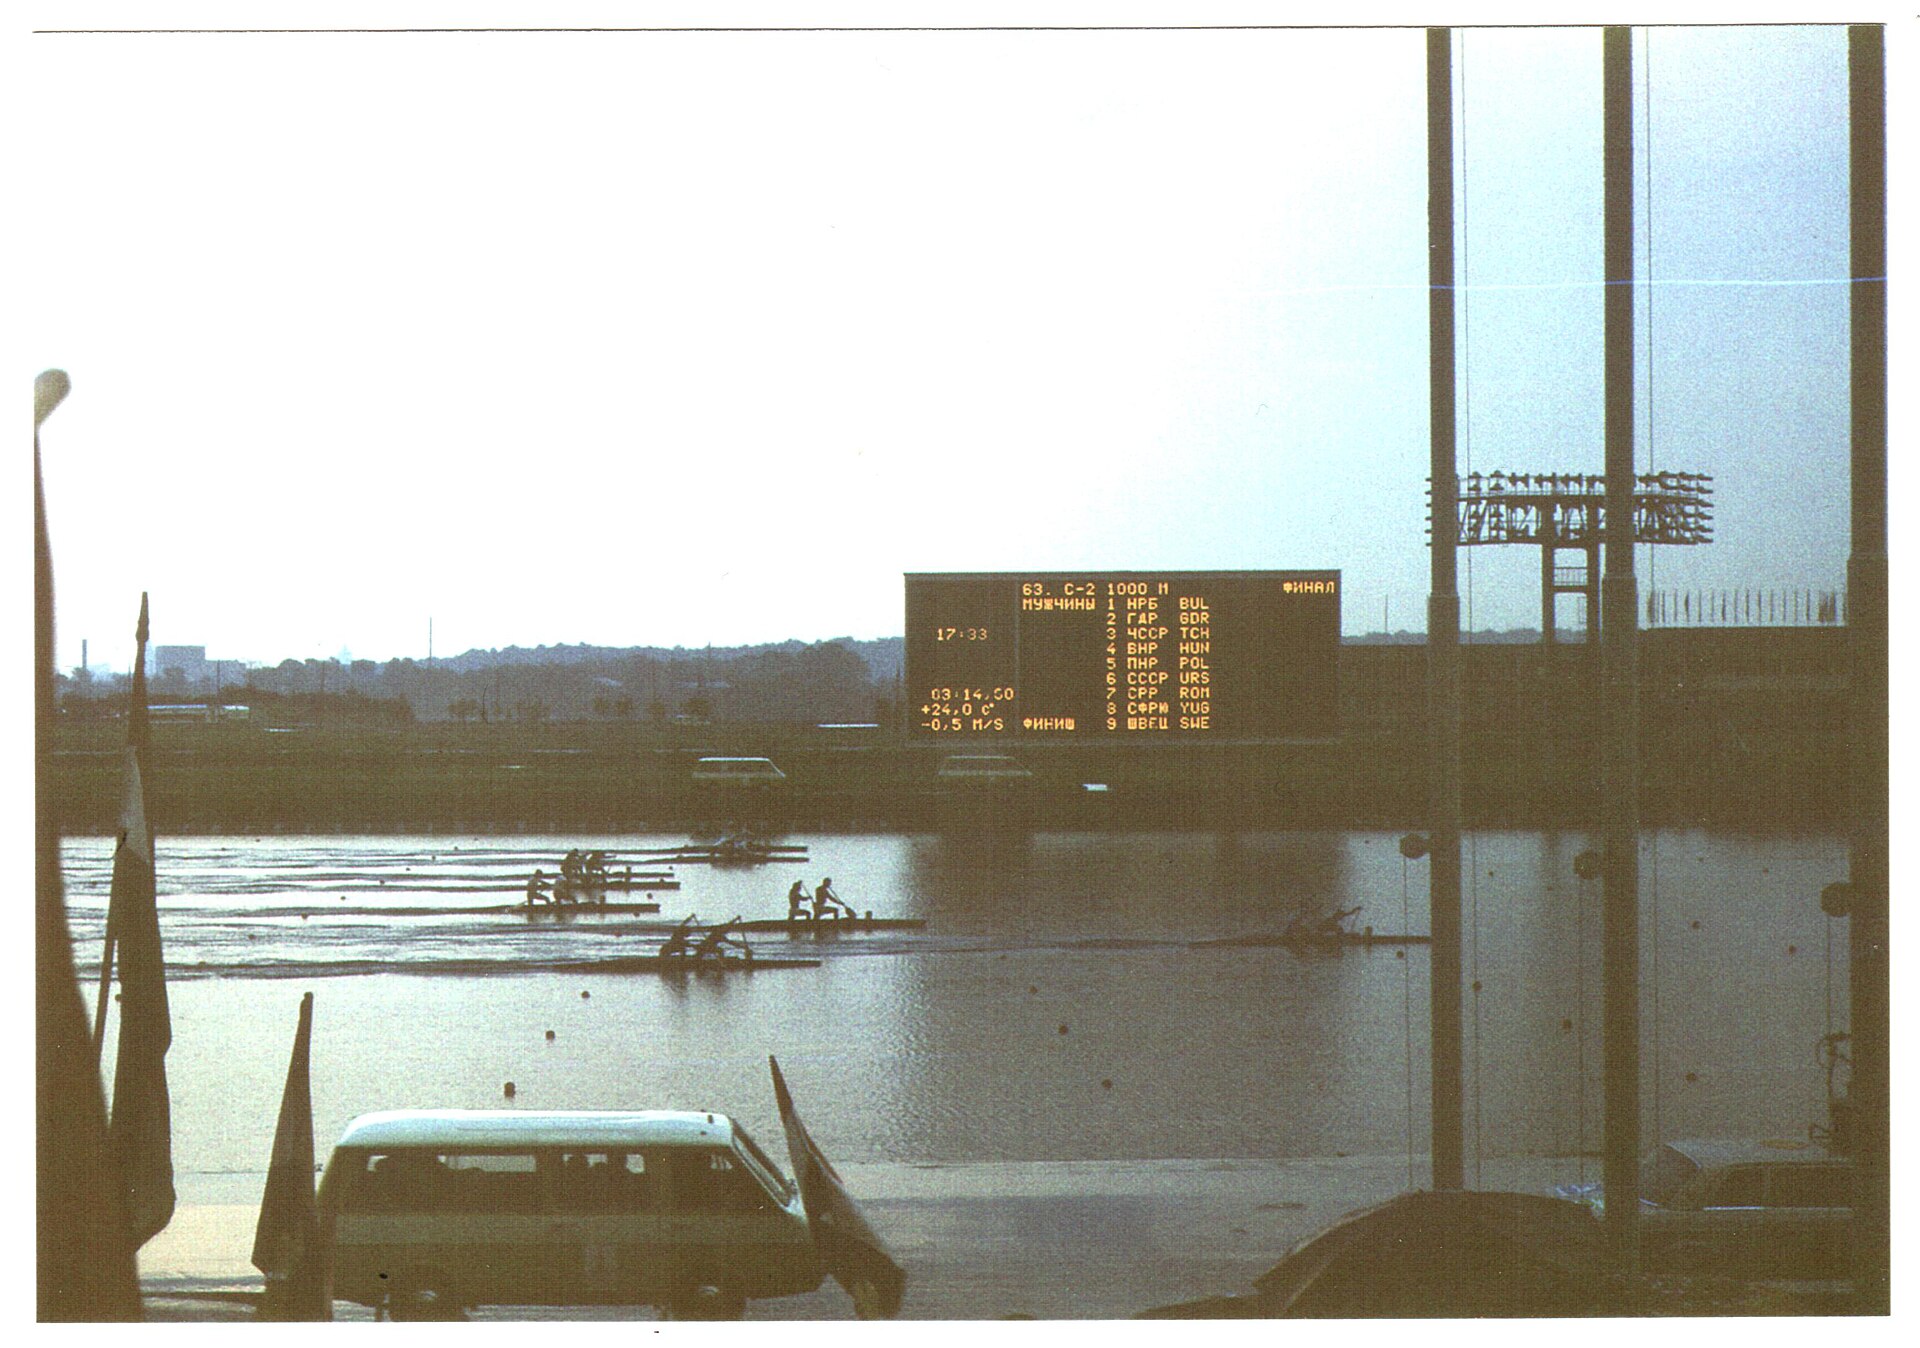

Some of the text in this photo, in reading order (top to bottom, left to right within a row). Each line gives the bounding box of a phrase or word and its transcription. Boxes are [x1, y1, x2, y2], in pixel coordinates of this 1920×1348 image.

[1022, 582, 1051, 596] 63.
[1107, 582, 1148, 596] 1000
[1282, 580, 1335, 594] ФИНАЛ
[1022, 597, 1096, 611] МУЖЧИНЫ
[1126, 596, 1159, 610] НРБ
[1179, 596, 1210, 610] BUL
[1106, 611, 1210, 626] 2 ГДР GDR
[937, 627, 988, 641] 17:33
[1106, 626, 1210, 640] 3 ЧССР TCH
[1106, 641, 1117, 655] 4
[1179, 641, 1210, 655] HUN
[1106, 655, 1210, 671] 5 ПНР POL
[1105, 670, 1210, 686] 6 СССР URS
[1106, 685, 1211, 700] 7 СРР ROM
[920, 702, 973, 716] +24,0
[1106, 700, 1210, 715] 8 СФРЮ YUG
[920, 717, 1004, 731] -0,5 M/S
[1022, 717, 1075, 731] ФИНИШ
[1106, 716, 1117, 731] 9
[1179, 715, 1210, 730] SWE
